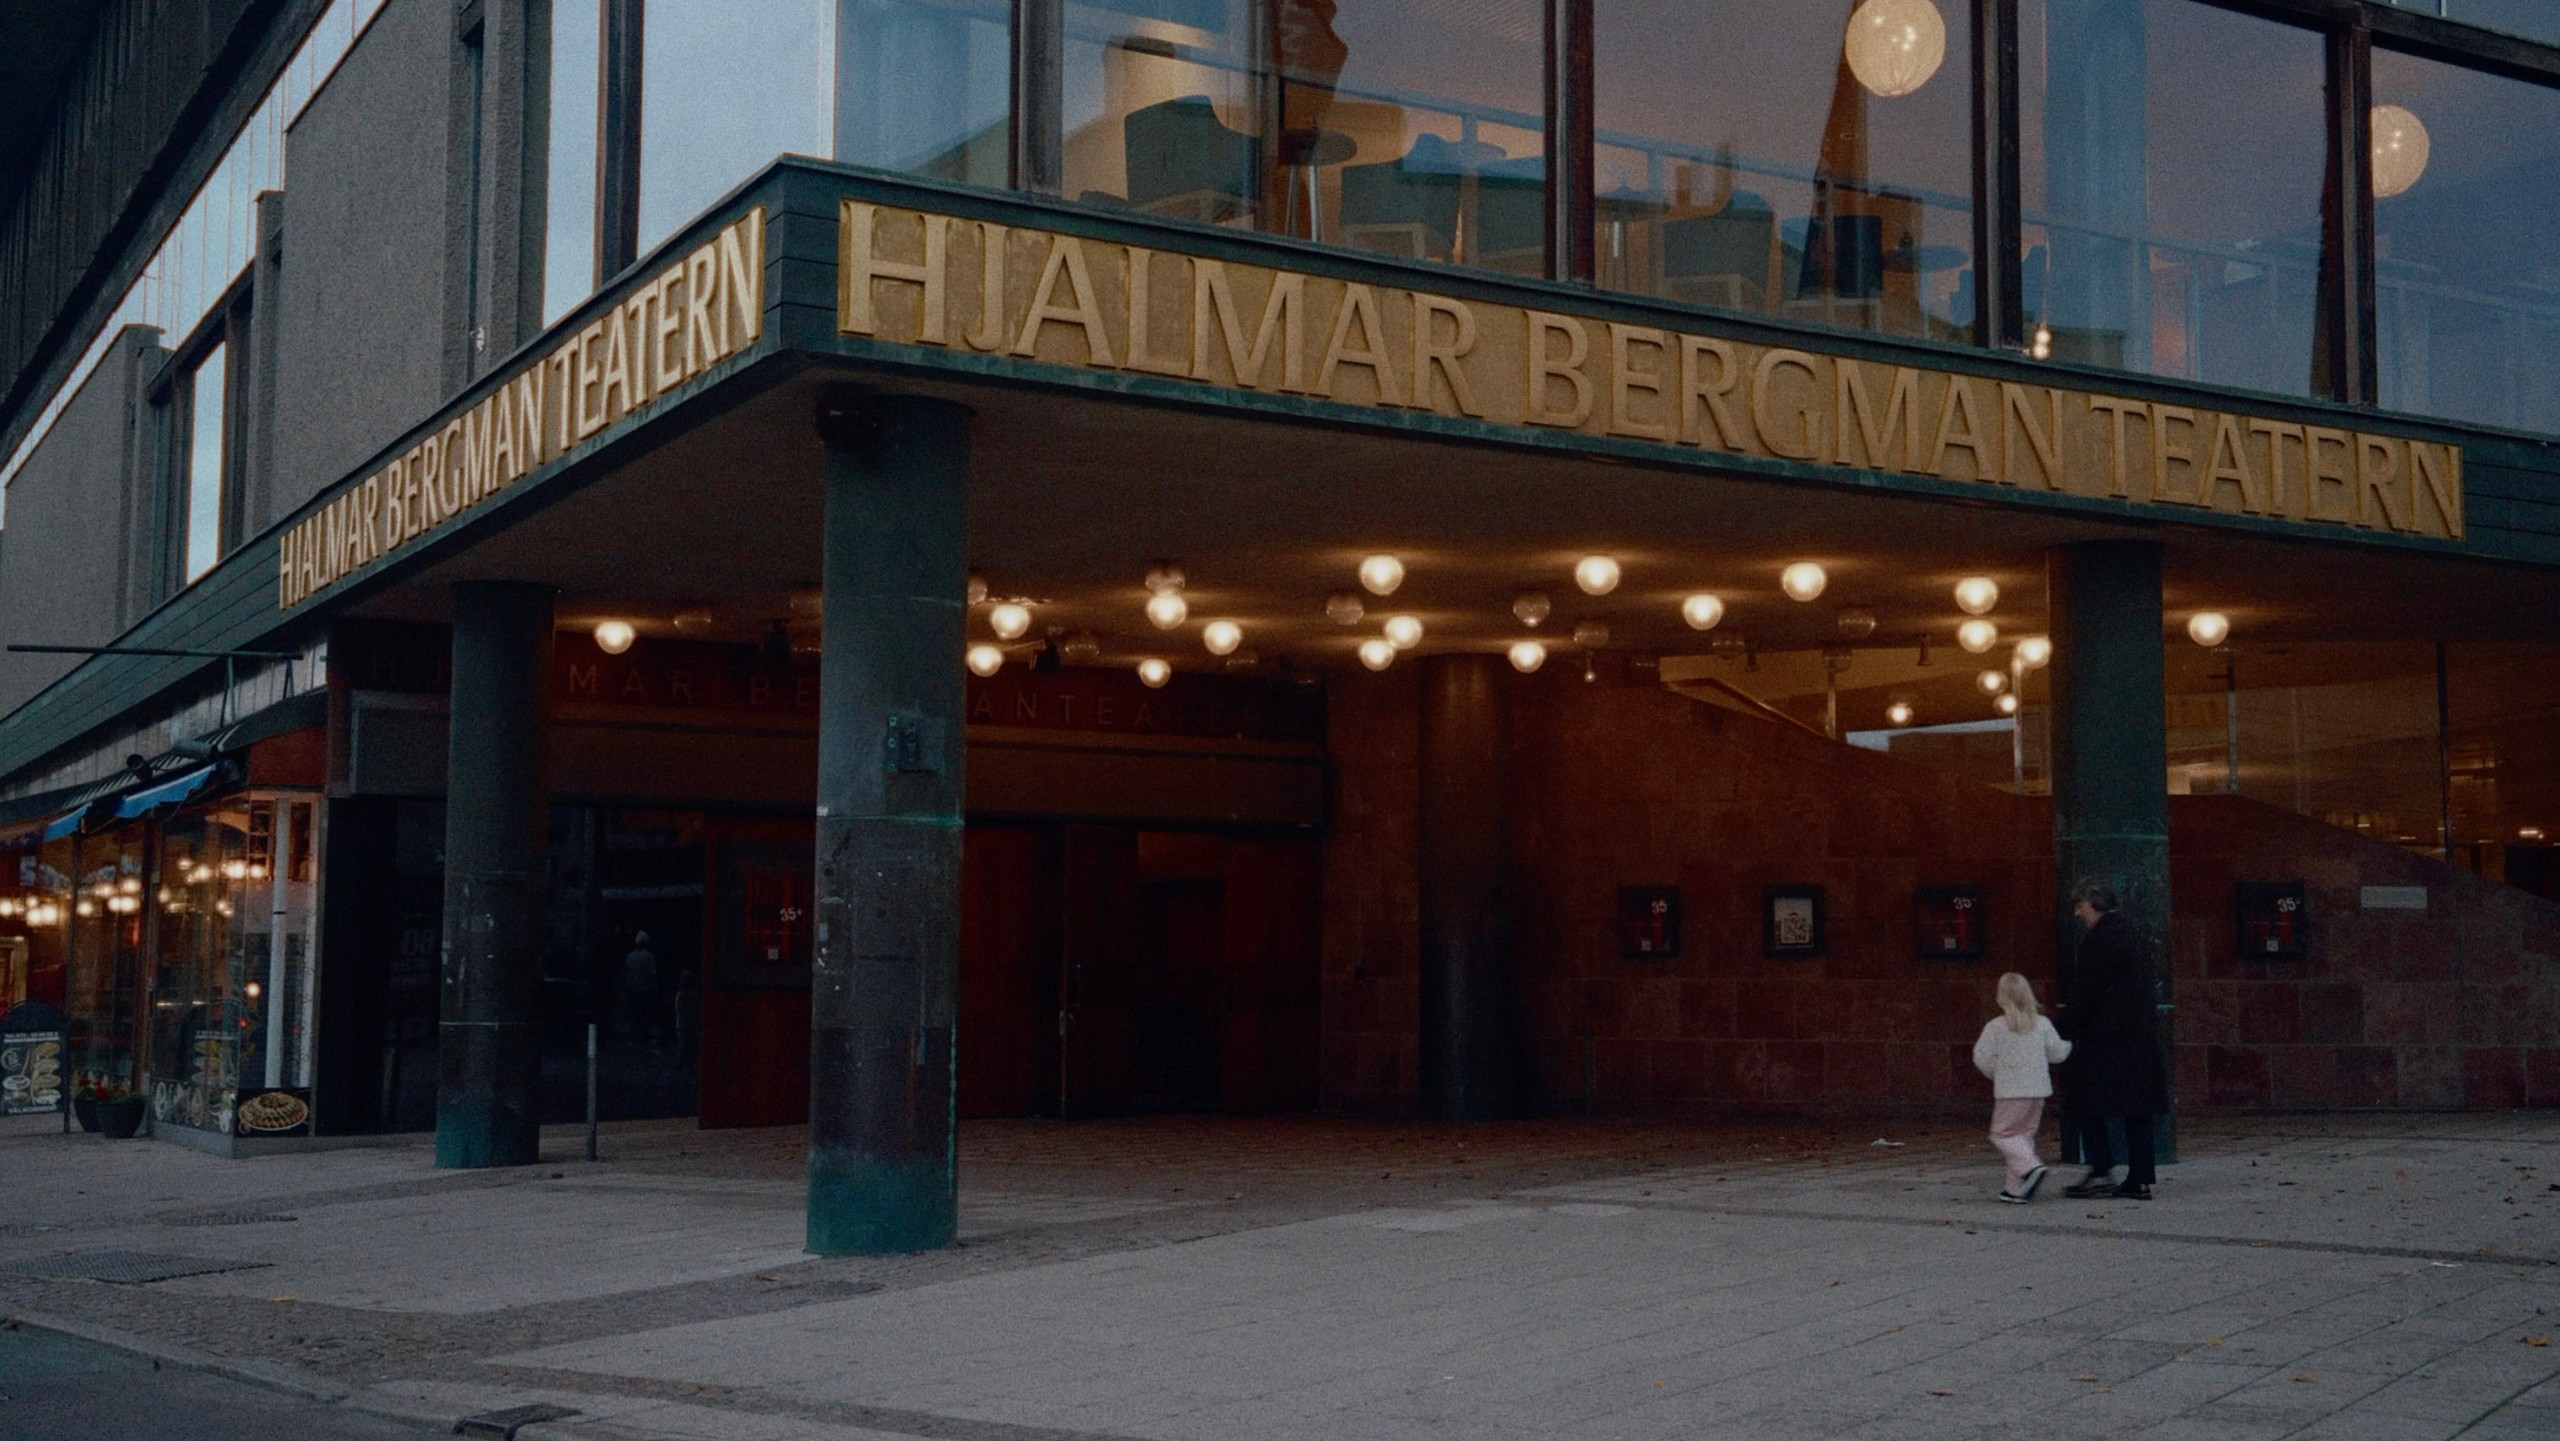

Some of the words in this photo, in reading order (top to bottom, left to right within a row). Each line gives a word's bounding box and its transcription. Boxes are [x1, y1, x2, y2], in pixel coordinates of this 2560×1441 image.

[279, 475, 380, 610] HJALMAR
[386, 359, 547, 550] BERGMAN
[555, 204, 766, 453] TEATERN
[839, 199, 1483, 418] HJALMAR
[1523, 308, 2063, 491] BERGMAN
[2090, 395, 2465, 541] TEATERN
